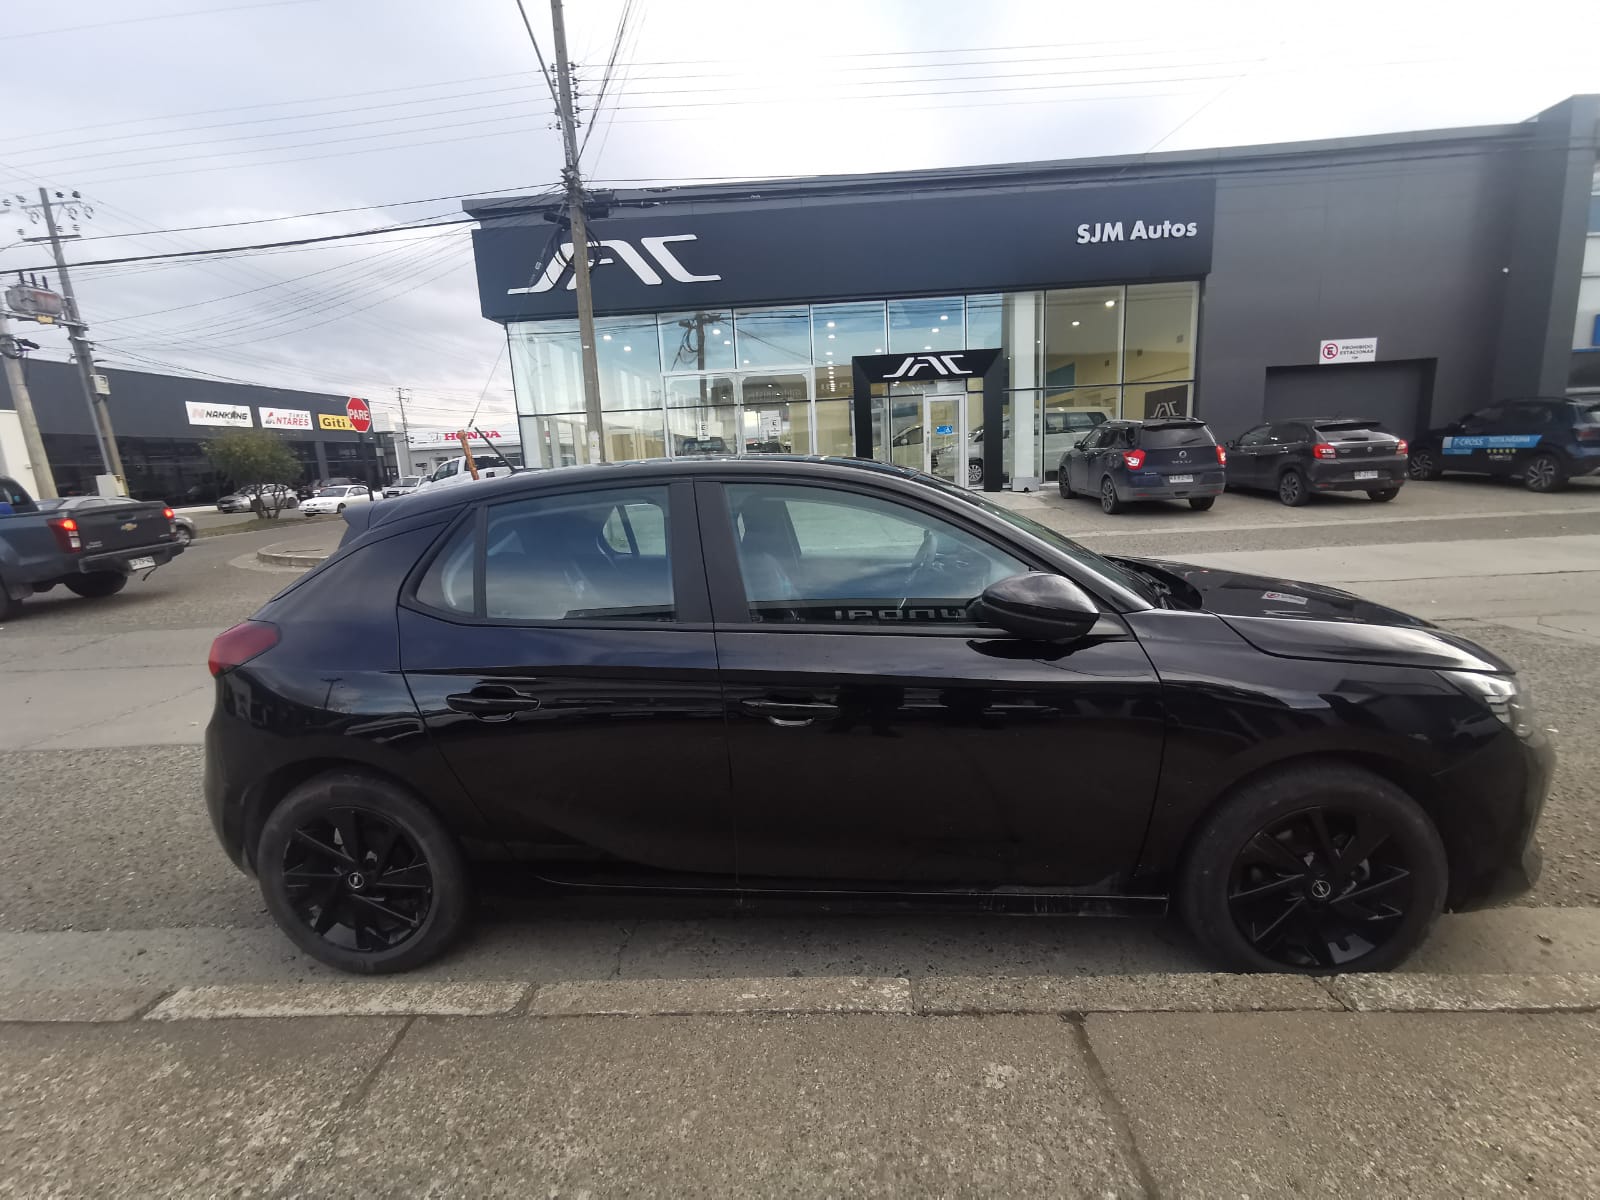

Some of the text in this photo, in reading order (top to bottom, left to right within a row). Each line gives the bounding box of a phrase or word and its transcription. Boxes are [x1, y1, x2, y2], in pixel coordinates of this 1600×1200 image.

[1077, 220, 1197, 244] SJM Autos
[507, 234, 722, 295] JAC
[883, 354, 973, 378] JAC
[322, 417, 346, 428] Giti
[349, 408, 370, 421] PARE
